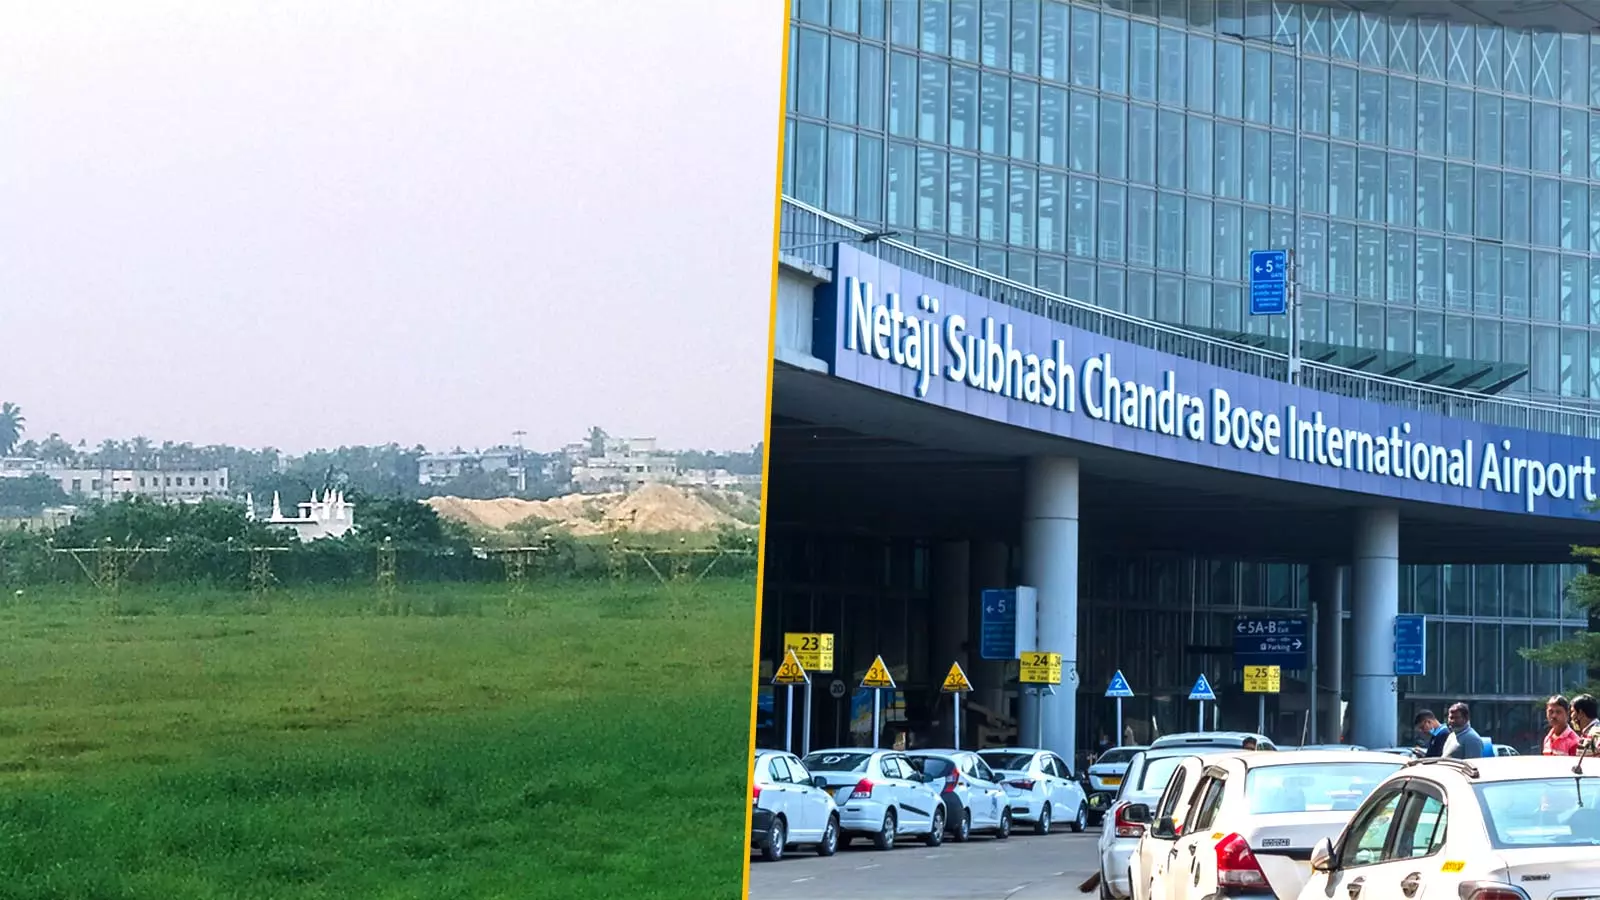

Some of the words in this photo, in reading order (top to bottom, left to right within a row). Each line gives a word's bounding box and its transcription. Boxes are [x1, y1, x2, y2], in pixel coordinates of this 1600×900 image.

[1265, 260, 1273, 273] 5
[847, 275, 940, 398] Netaji
[945, 313, 1076, 413] Subhash
[1081, 352, 1206, 442] Chandra
[1210, 387, 1281, 456] Bose
[1286, 404, 1473, 489] International
[1479, 439, 1597, 513] Airport
[997, 599, 1006, 614] 5
[1247, 620, 1277, 634] 5A-B
[801, 636, 819, 651] 23
[1267, 643, 1291, 652] Parking
[1033, 654, 1048, 666] 24
[782, 662, 800, 676] 30
[869, 667, 886, 680] 31
[1255, 667, 1268, 678] 25
[948, 672, 964, 684] 32
[1114, 678, 1122, 689] 2
[1198, 680, 1206, 691] 3
